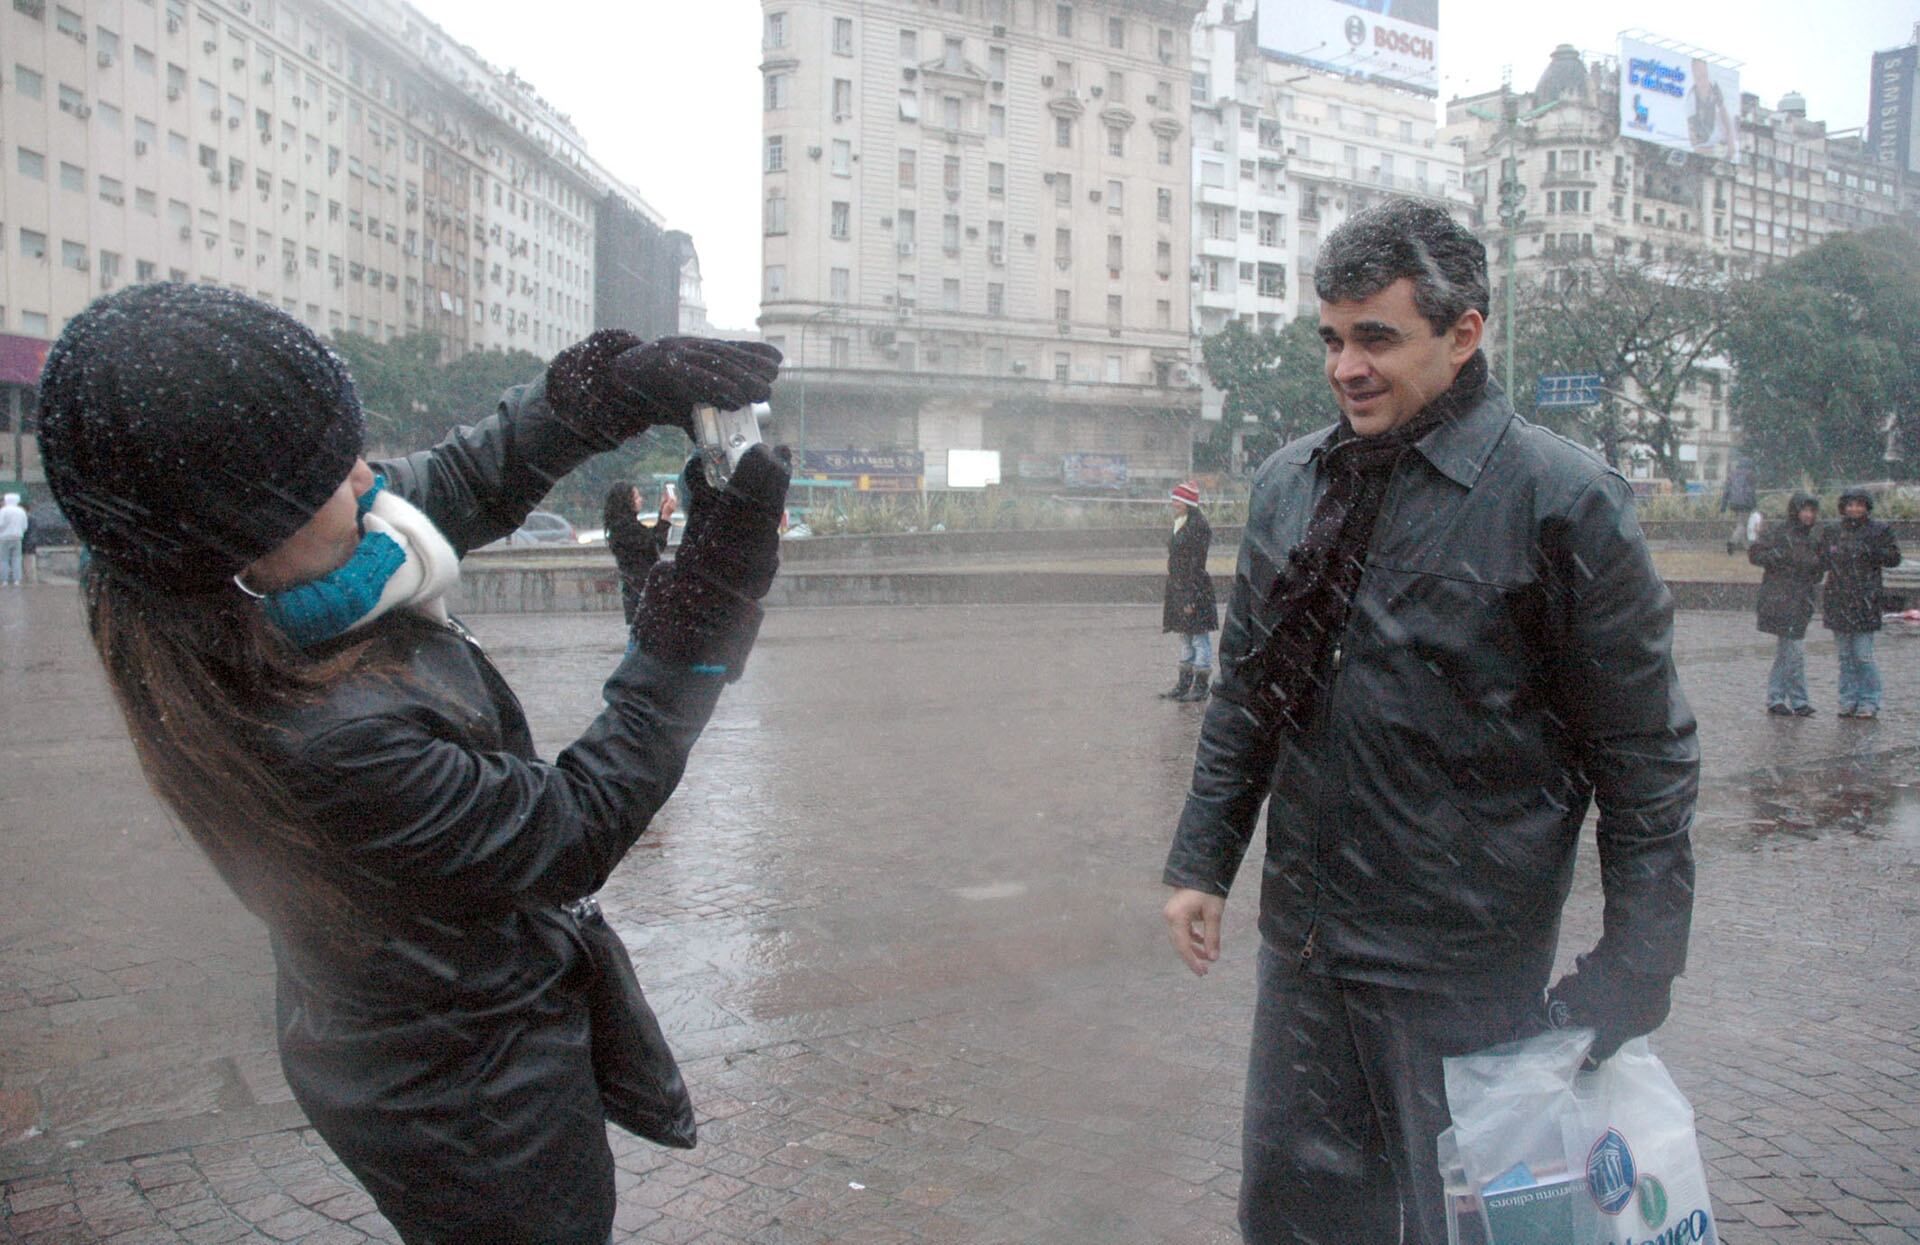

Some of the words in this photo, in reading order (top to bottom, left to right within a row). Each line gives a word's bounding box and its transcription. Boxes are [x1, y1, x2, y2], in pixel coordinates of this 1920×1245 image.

[1373, 25, 1433, 61] BOSCH
[1879, 57, 1901, 160] SAMSUNG
[1488, 1193, 1534, 1209] editores
